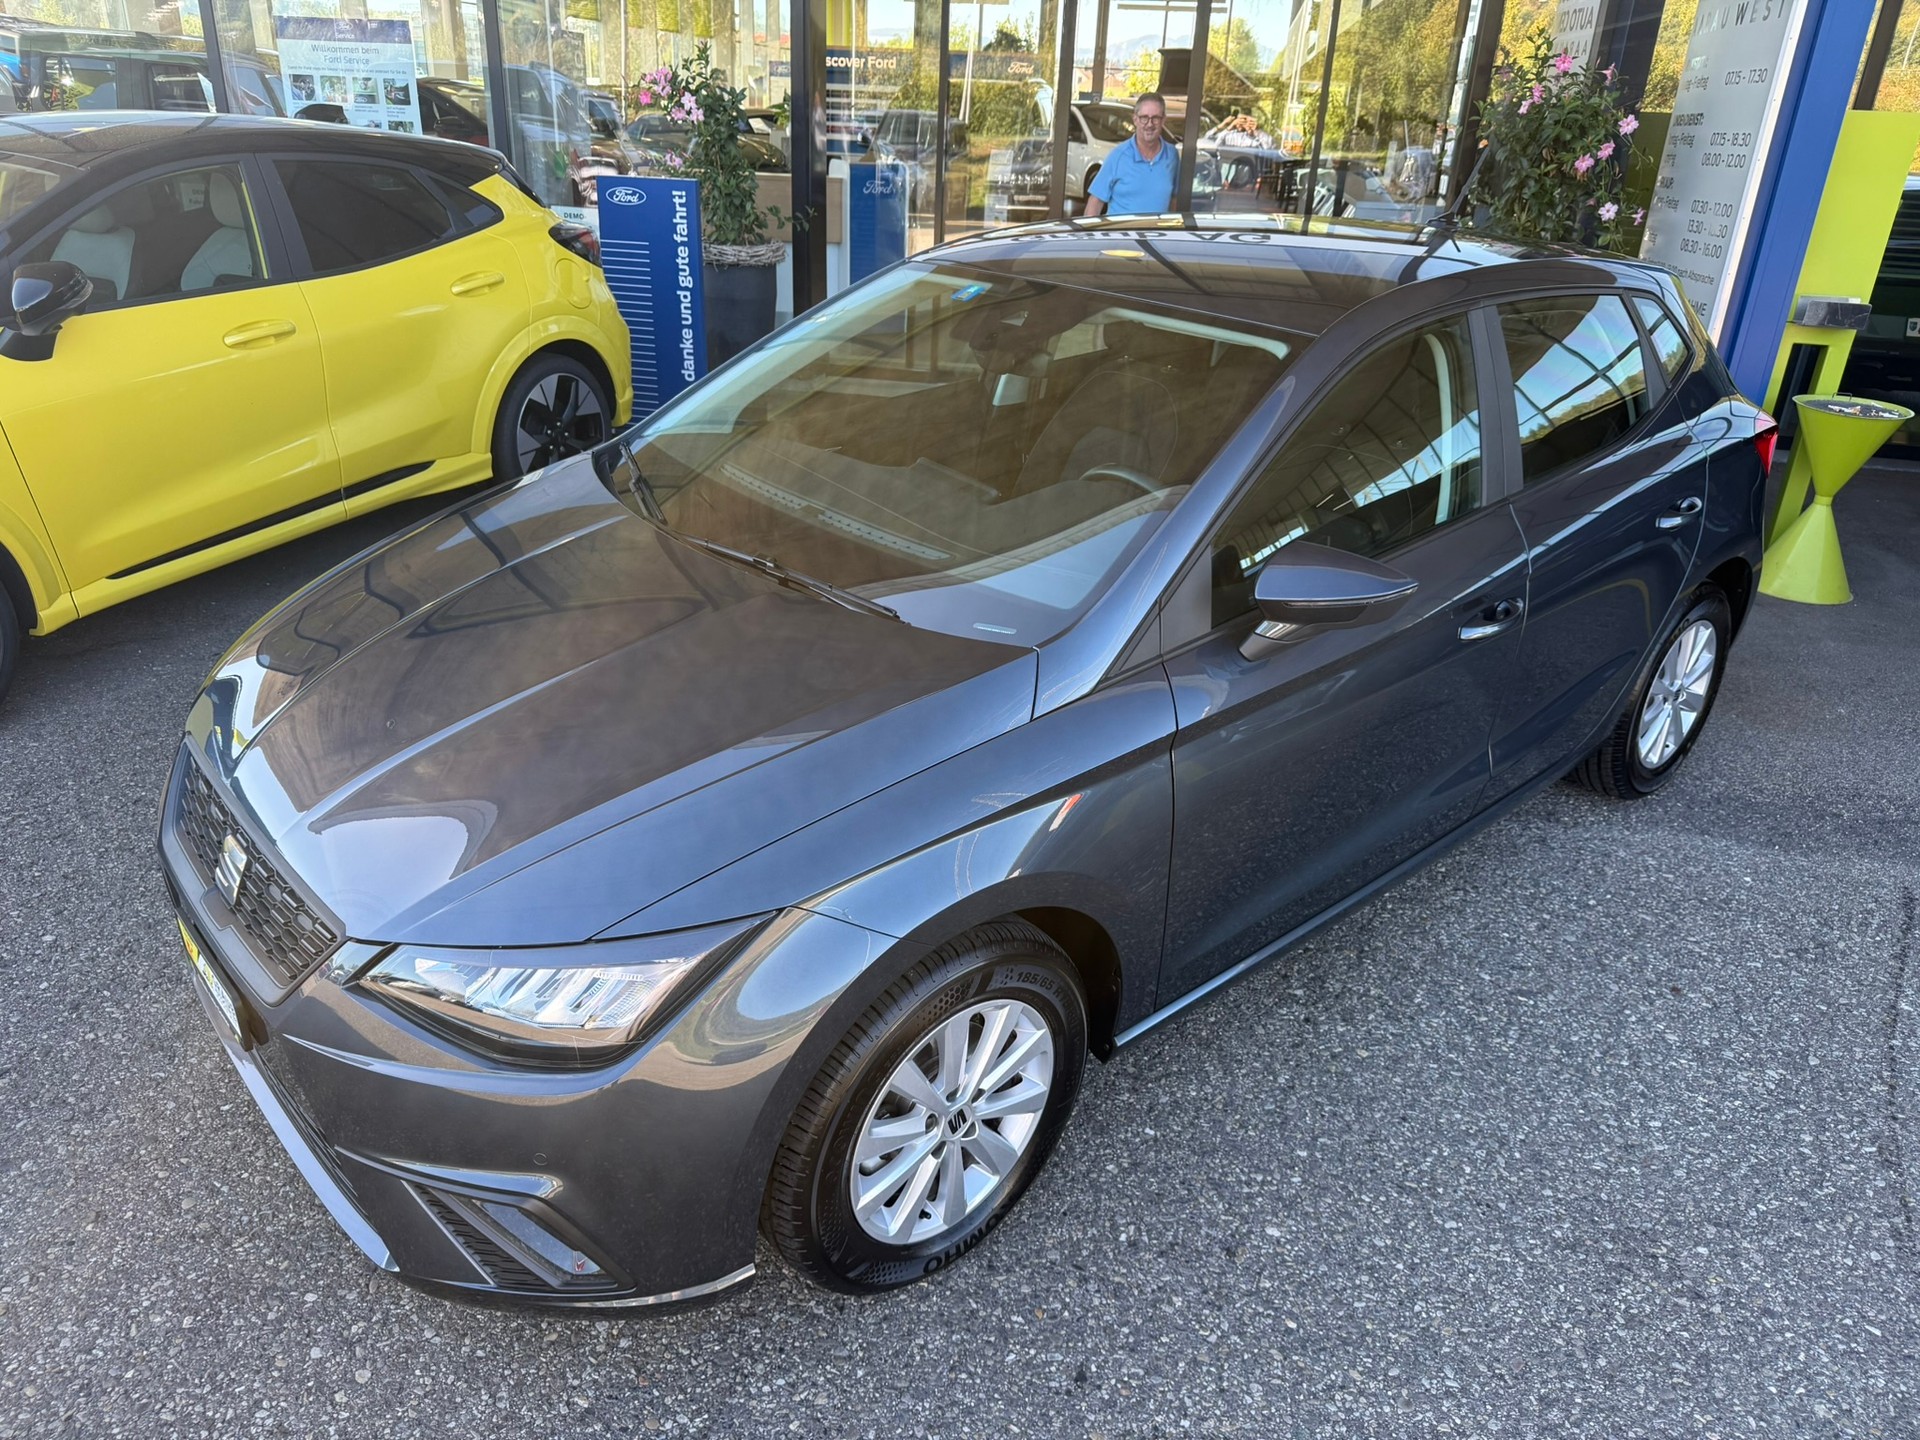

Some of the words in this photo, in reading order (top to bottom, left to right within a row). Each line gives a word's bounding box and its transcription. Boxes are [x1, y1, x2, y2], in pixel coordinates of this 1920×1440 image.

[311, 44, 360, 54] Willkommen
[361, 46, 380, 55] beim
[323, 55, 342, 63] Ford
[344, 56, 370, 65] Service
[826, 56, 865, 69] scover
[867, 56, 897, 69] Ford
[1007, 61, 1035, 75] Ford
[1724, 71, 1742, 86] 07.15
[1747, 68, 1769, 85] 17.30
[1710, 132, 1727, 147] 07.15
[1731, 132, 1752, 147] 18.30
[1701, 152, 1721, 167] 08.00
[1725, 153, 1747, 168] 12.00
[611, 187, 641, 204] Ford
[863, 179, 893, 195] Ford
[672, 190, 689, 243] fahrt!
[1690, 199, 1709, 215] 07.30
[1712, 201, 1733, 218] 12.00
[1680, 238, 1699, 254] 08.30
[1702, 242, 1722, 259] 16.00
[675, 245, 694, 288] gute
[1688, 269, 1715, 286] Absprache
[677, 290, 693, 325] und
[679, 329, 696, 382] danke
[1016, 971, 1056, 991] 185/65
